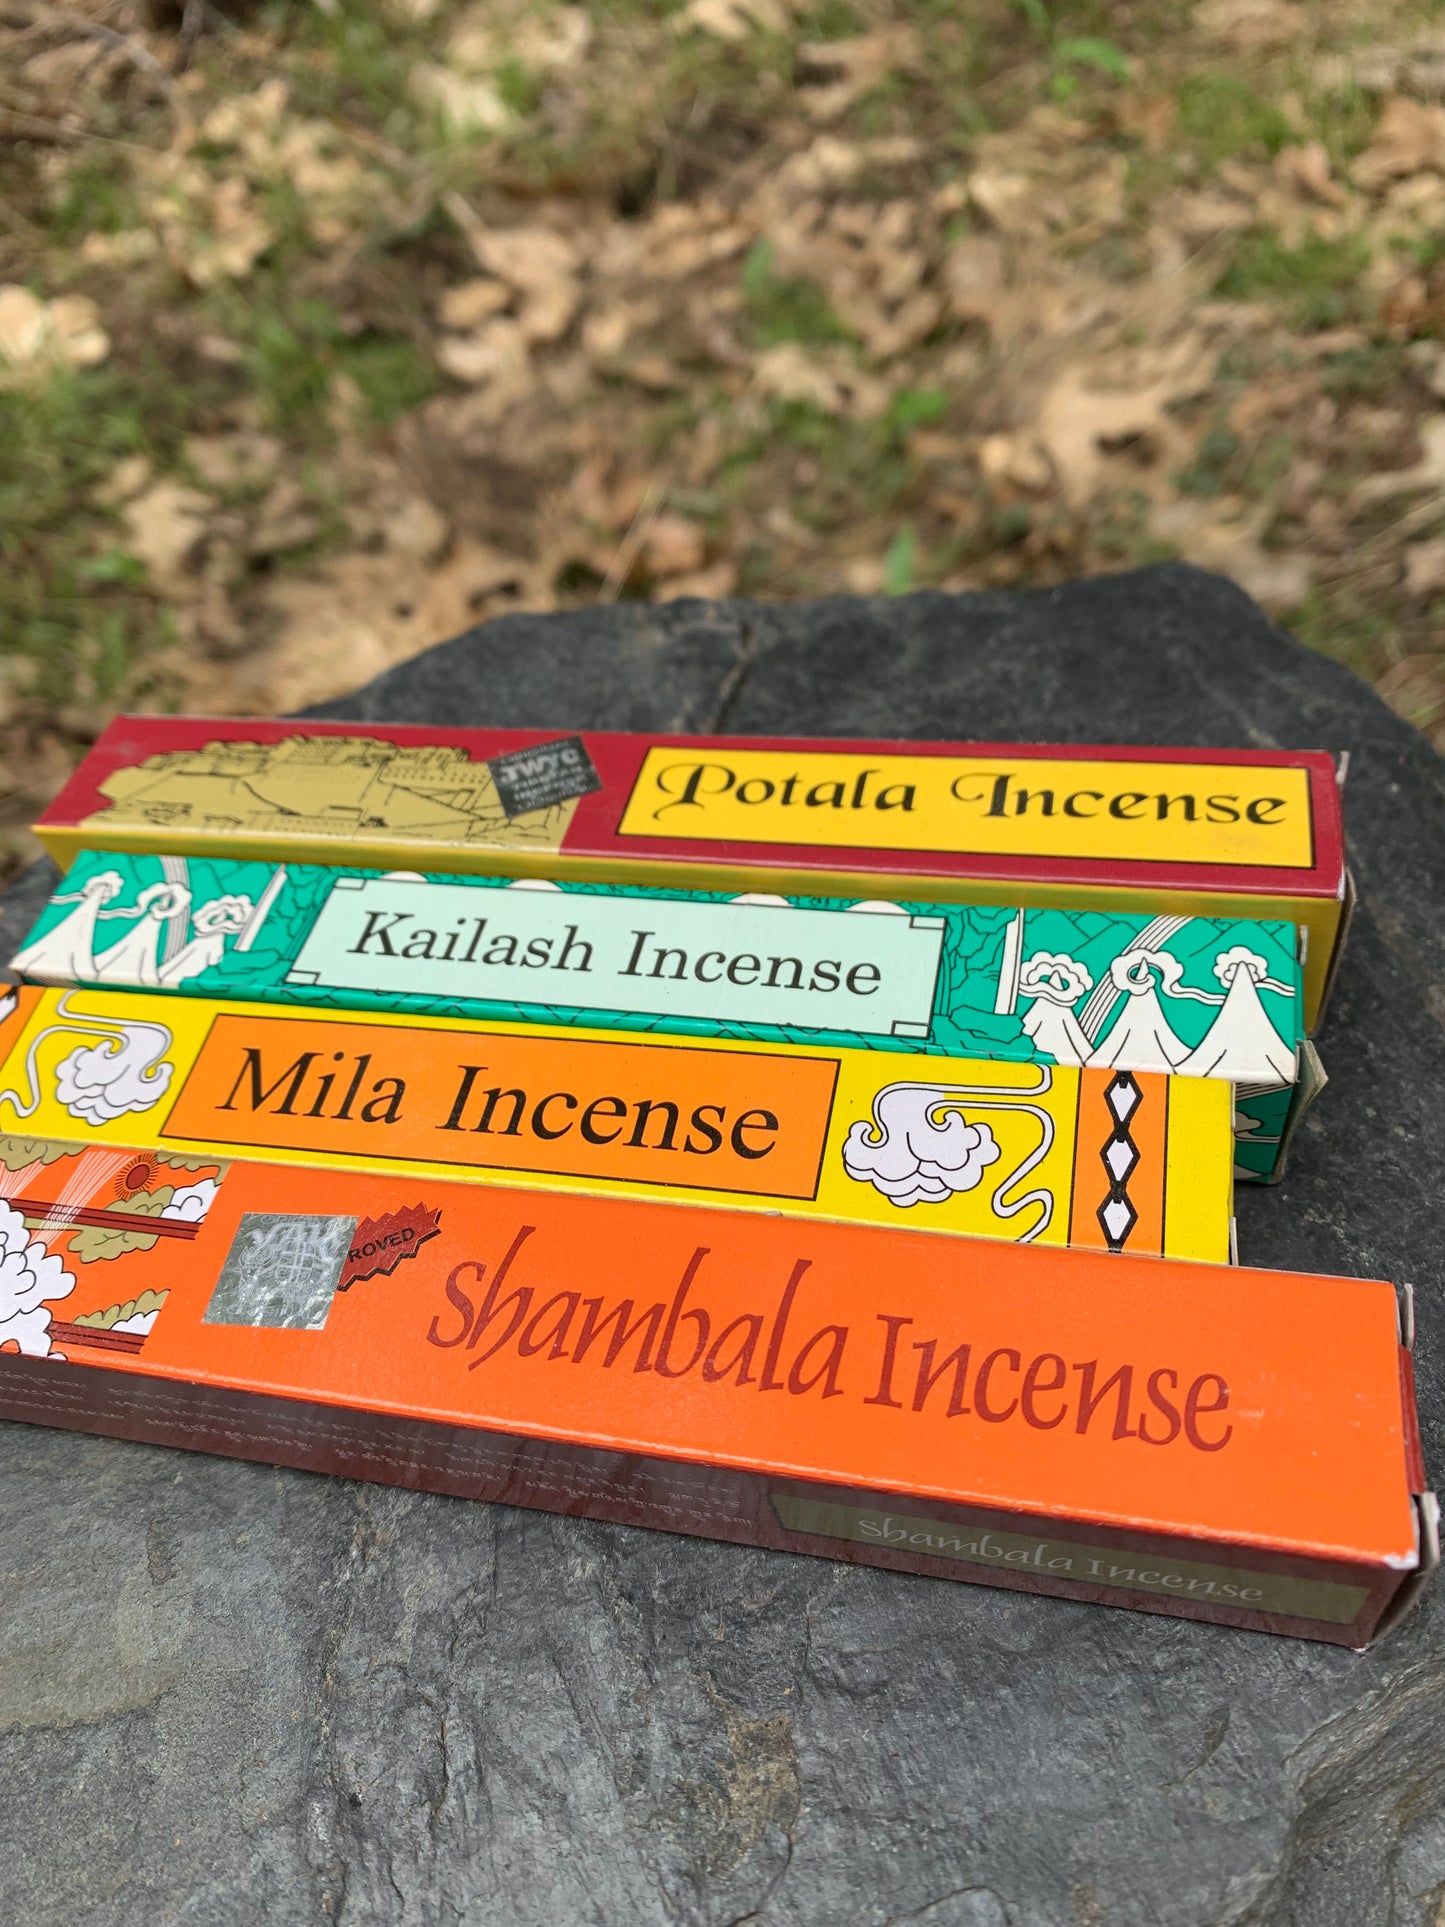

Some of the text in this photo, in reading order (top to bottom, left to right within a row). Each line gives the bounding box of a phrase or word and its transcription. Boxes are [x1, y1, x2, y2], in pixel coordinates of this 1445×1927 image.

[652, 763, 1287, 825] Potala Incense
[346, 911, 882, 996] Kailash Incense
[215, 1048, 779, 1160] Mila Incense
[863, 1313, 1233, 1452] Incense
[1086, 1558, 1264, 1601] Incense
